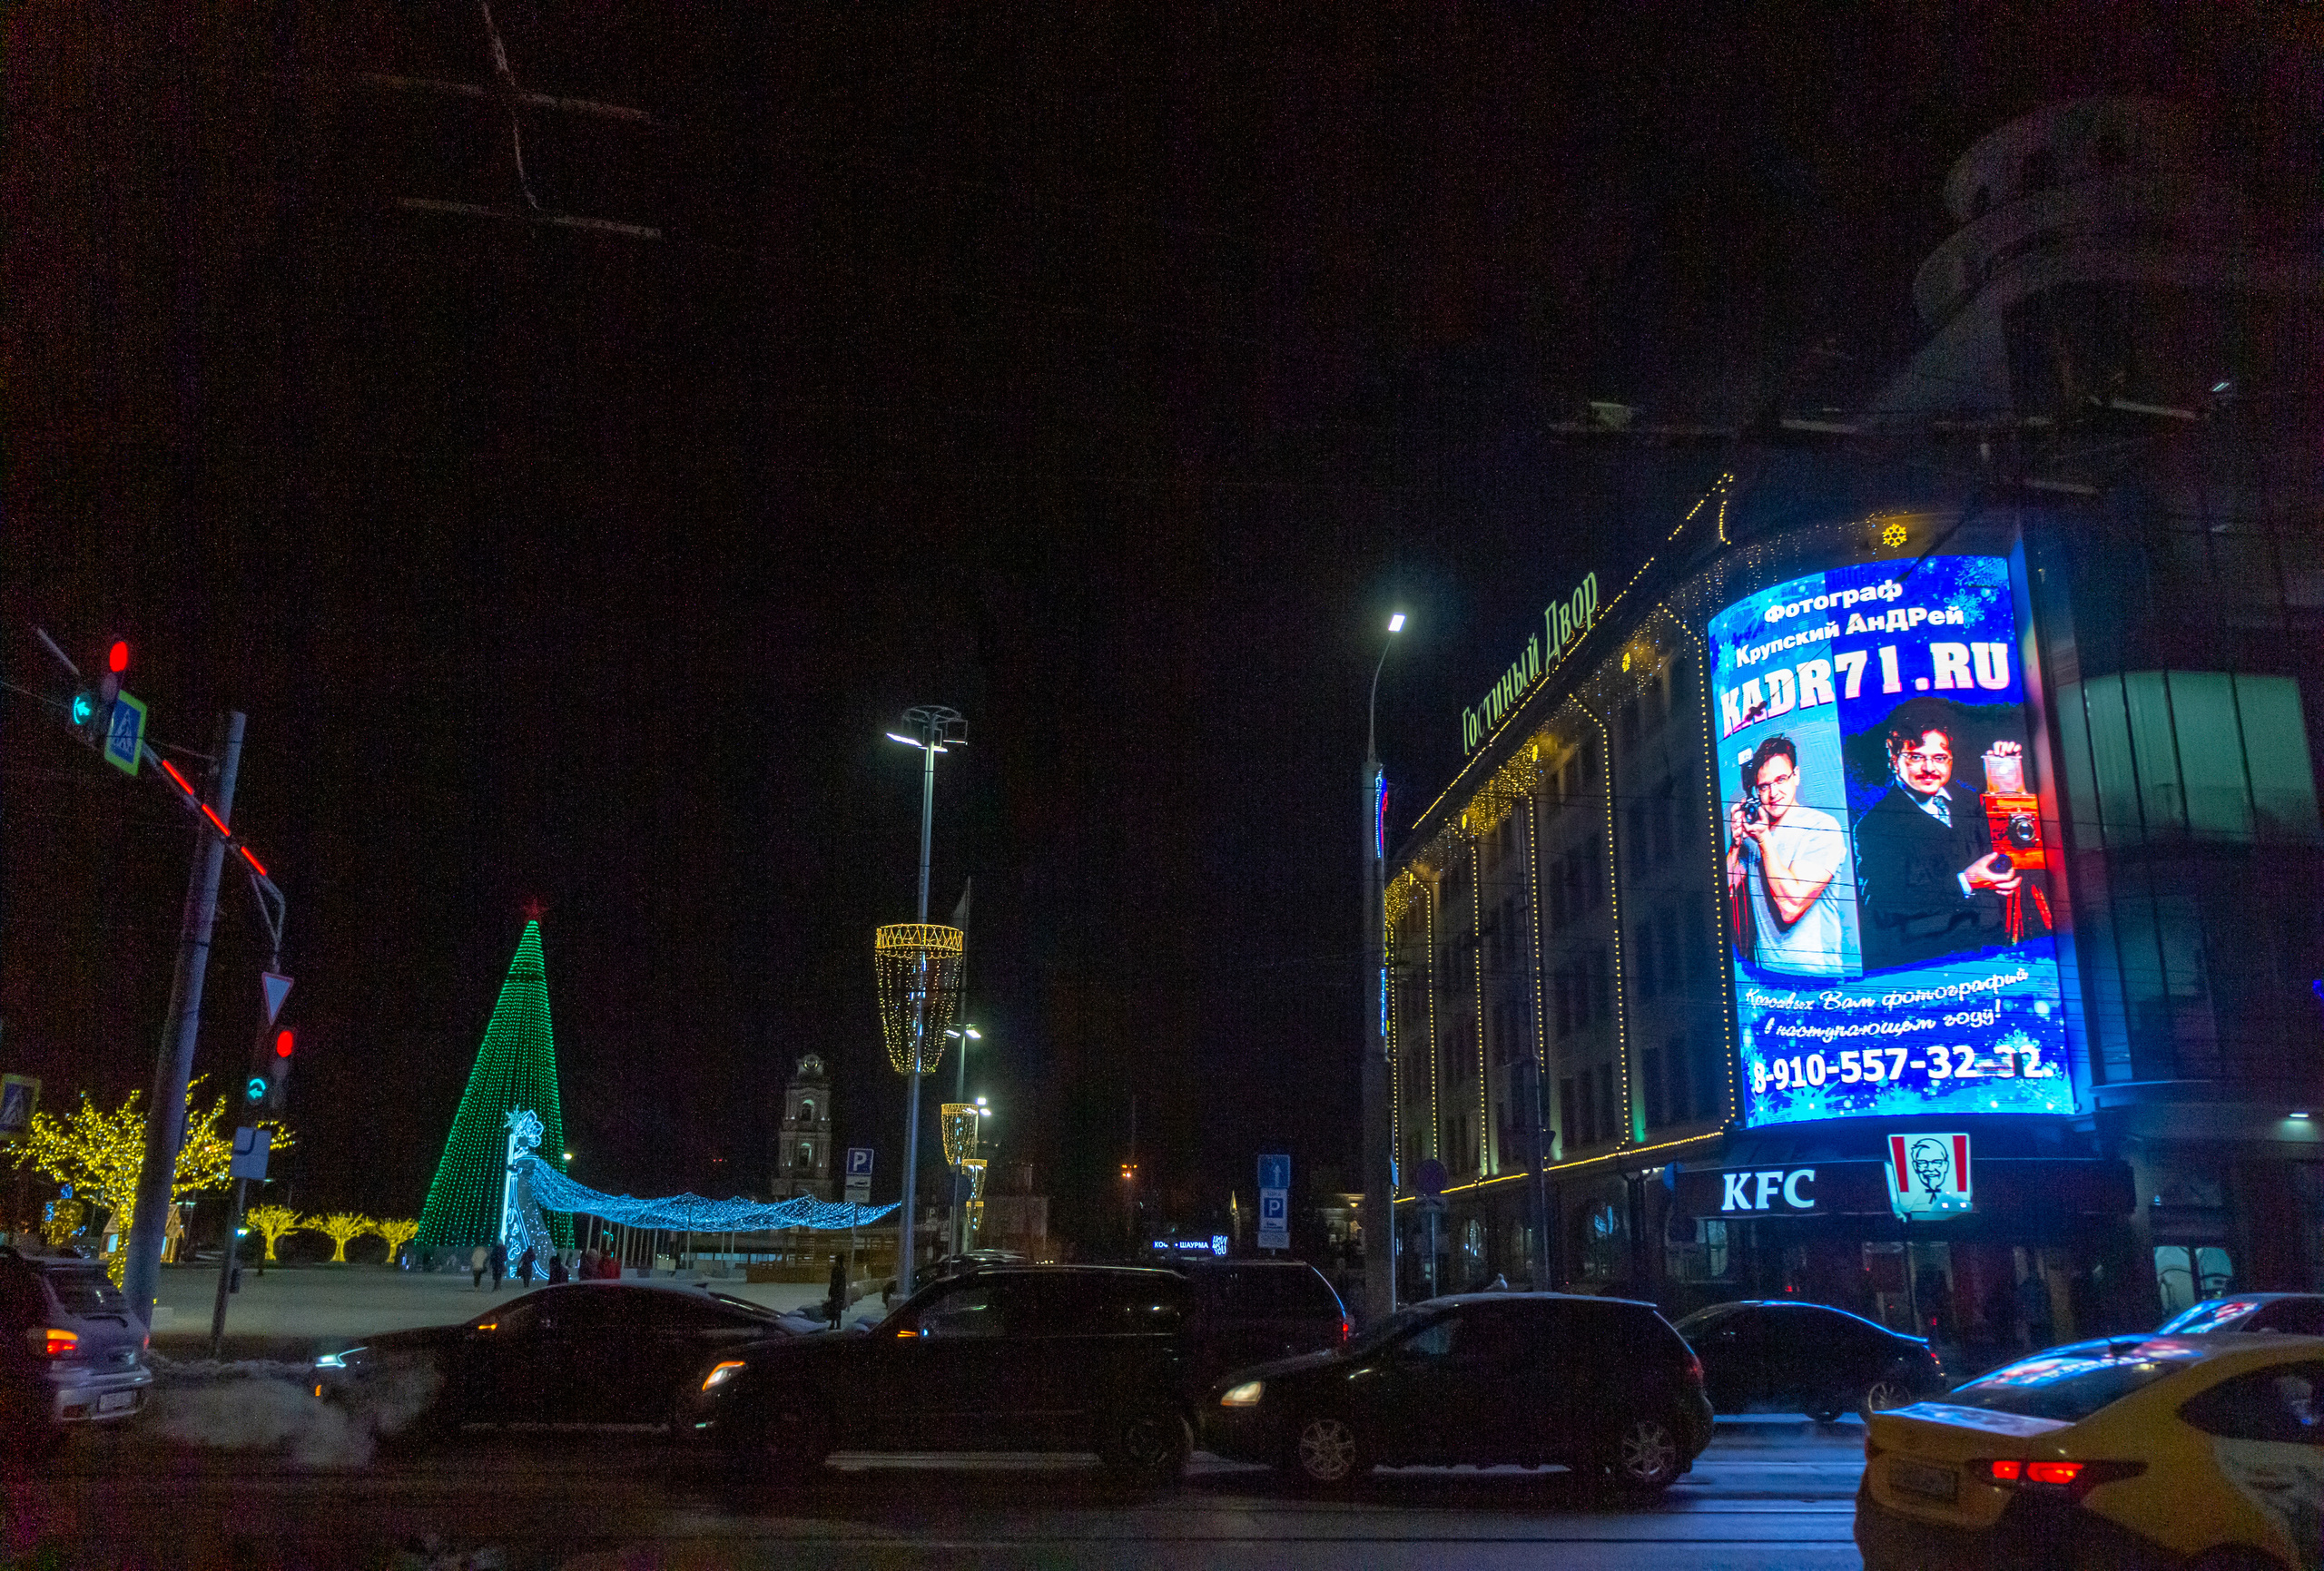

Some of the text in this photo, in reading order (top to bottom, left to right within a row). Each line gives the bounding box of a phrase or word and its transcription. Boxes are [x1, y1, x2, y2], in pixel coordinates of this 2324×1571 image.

[1764, 579, 1903, 624] Фотограф
[1462, 572, 1598, 754] Гостиный Двор
[1736, 622, 1839, 668] Крупский
[1720, 643, 2010, 739] KADR71.RU
[1819, 990, 1876, 1011] Вам
[1882, 968, 2029, 1011] фотографий
[1776, 1018, 1936, 1043] наступающем
[853, 1152, 867, 1171] P
[1269, 1200, 1281, 1216] P
[1721, 1169, 1816, 1211] KFC
